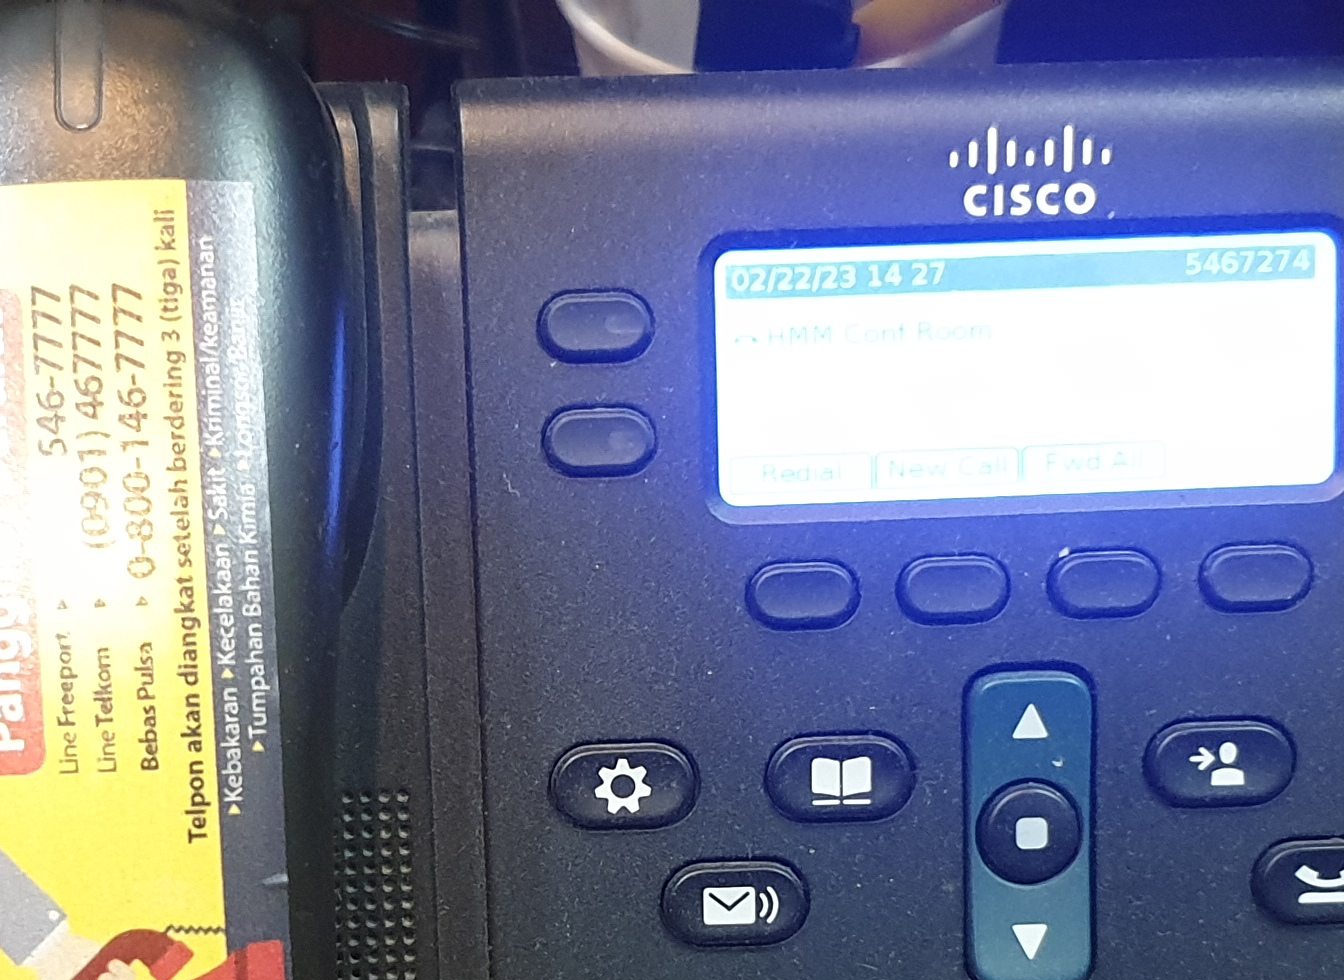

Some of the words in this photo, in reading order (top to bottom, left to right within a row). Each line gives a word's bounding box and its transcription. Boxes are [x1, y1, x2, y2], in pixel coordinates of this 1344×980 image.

[153, 208, 176, 251] kali
[964, 183, 1096, 216] CISCO
[157, 257, 184, 321] (tiga)
[731, 266, 857, 294] 02/22/23
[1185, 249, 1311, 275] 5467274
[68, 283, 104, 420] 467777
[160, 328, 180, 341] 3
[197, 235, 224, 445] Kriminal/keamanan
[767, 325, 833, 347] HMM
[843, 322, 908, 345] Conf
[916, 321, 993, 342] Room
[30, 284, 67, 456] 546-7777
[111, 282, 156, 578] 0-800-146-7777
[161, 349, 187, 471] berdering
[75, 429, 115, 548] (0901)
[206, 466, 228, 519] Sakit
[761, 462, 842, 484] Redial
[887, 459, 948, 479] New
[958, 456, 1008, 476] Call
[1044, 451, 1102, 473] Fwd
[167, 478, 192, 567] setelah
[212, 541, 236, 665] Kecelakaan
[239, 547, 262, 617] Bahan
[173, 574, 201, 686] diangkat
[92, 646, 115, 727] Telkom
[133, 640, 156, 700] Pulsa
[245, 621, 271, 738] Tumpahan
[58, 731, 78, 774] Line
[96, 729, 117, 773] Line
[137, 703, 159, 770] Bebas
[180, 692, 202, 752] akan
[220, 686, 244, 800] Kebakaran
[184, 759, 211, 843] Telpon
